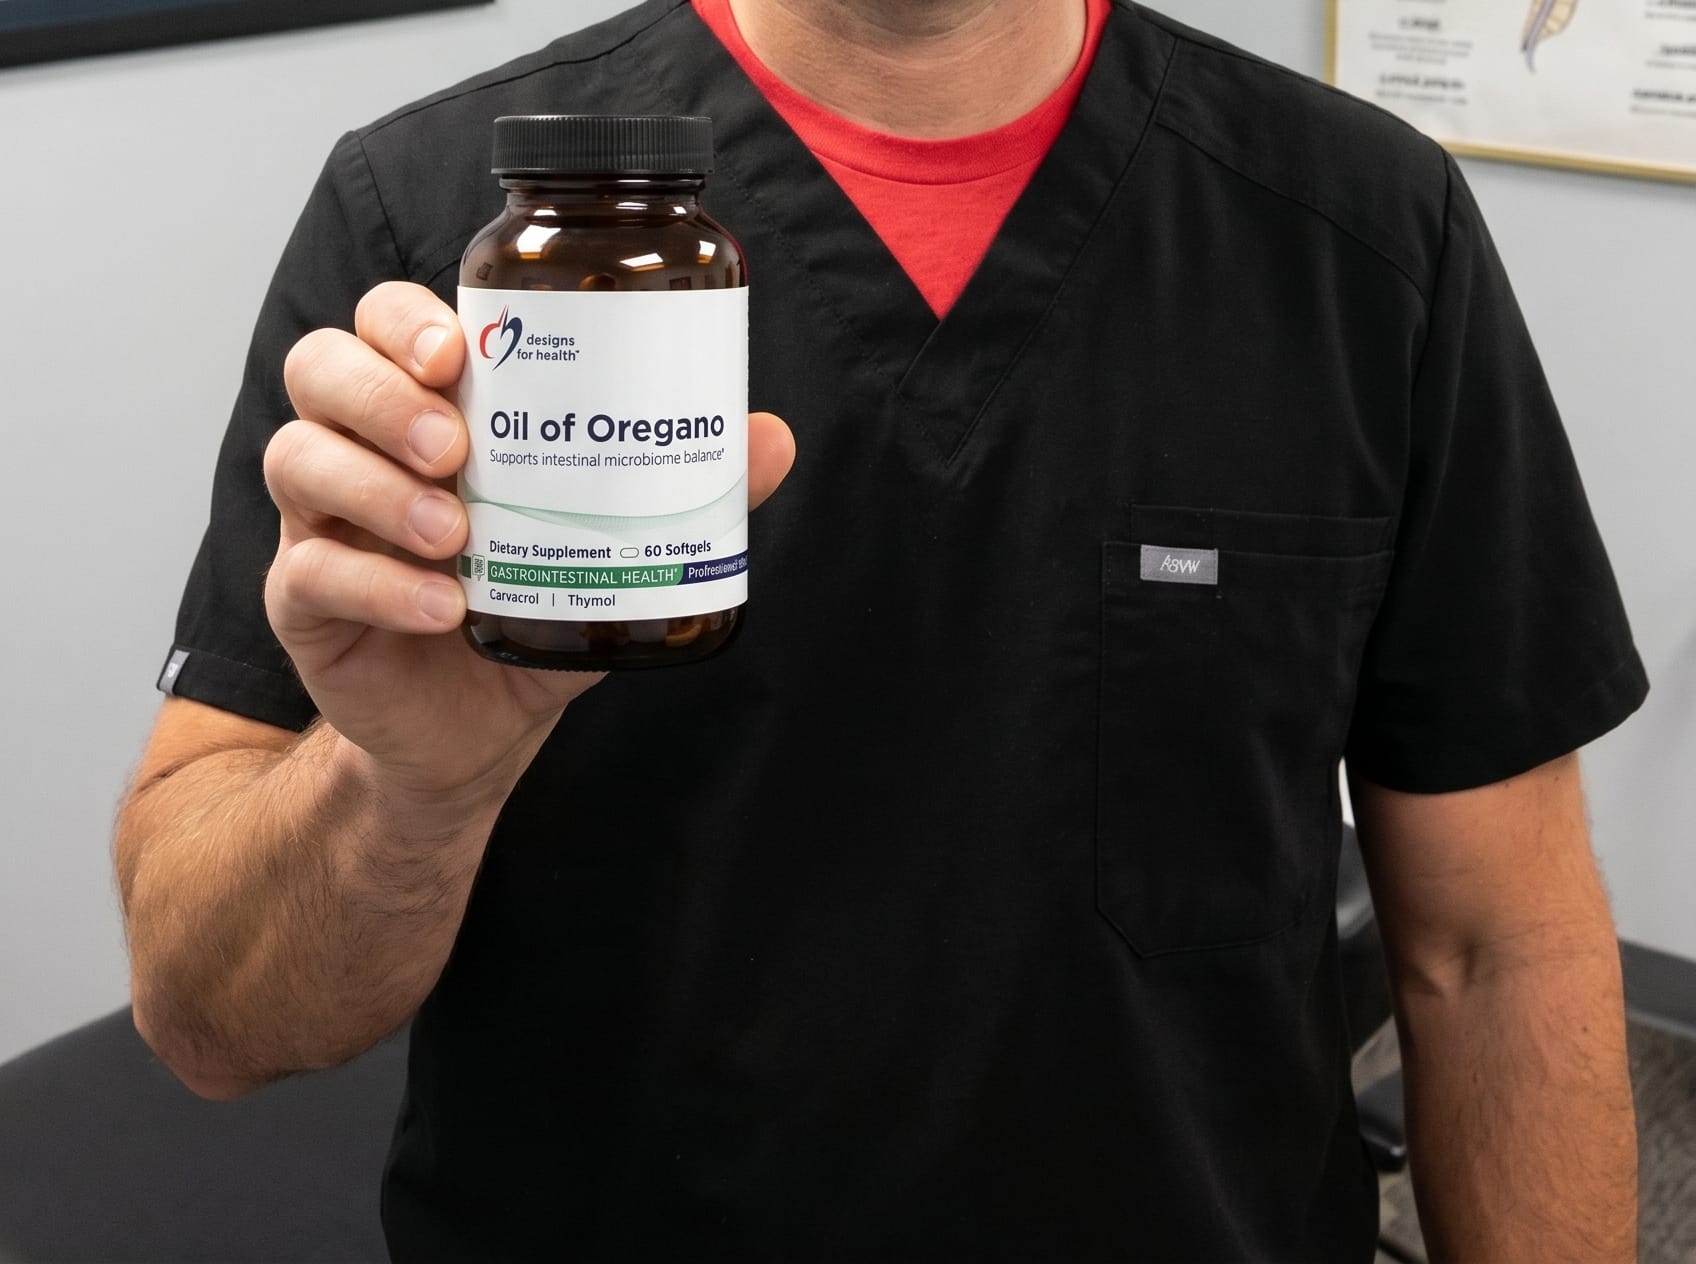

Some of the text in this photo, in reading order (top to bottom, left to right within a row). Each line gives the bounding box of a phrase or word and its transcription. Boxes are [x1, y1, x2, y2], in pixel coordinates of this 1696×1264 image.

[526, 334, 575, 348] designs
[517, 349, 534, 360] for
[490, 410, 725, 447] Oil of Oregano
[490, 449, 539, 466] Supports
[542, 452, 601, 467] intestinal
[604, 452, 681, 467] microbiome
[489, 540, 712, 560] Dietary Supplement 60 Softgels
[490, 565, 618, 584] GASTROINTESTINAL
[489, 588, 539, 604] Carvacrol
[568, 594, 616, 609] Thymol
